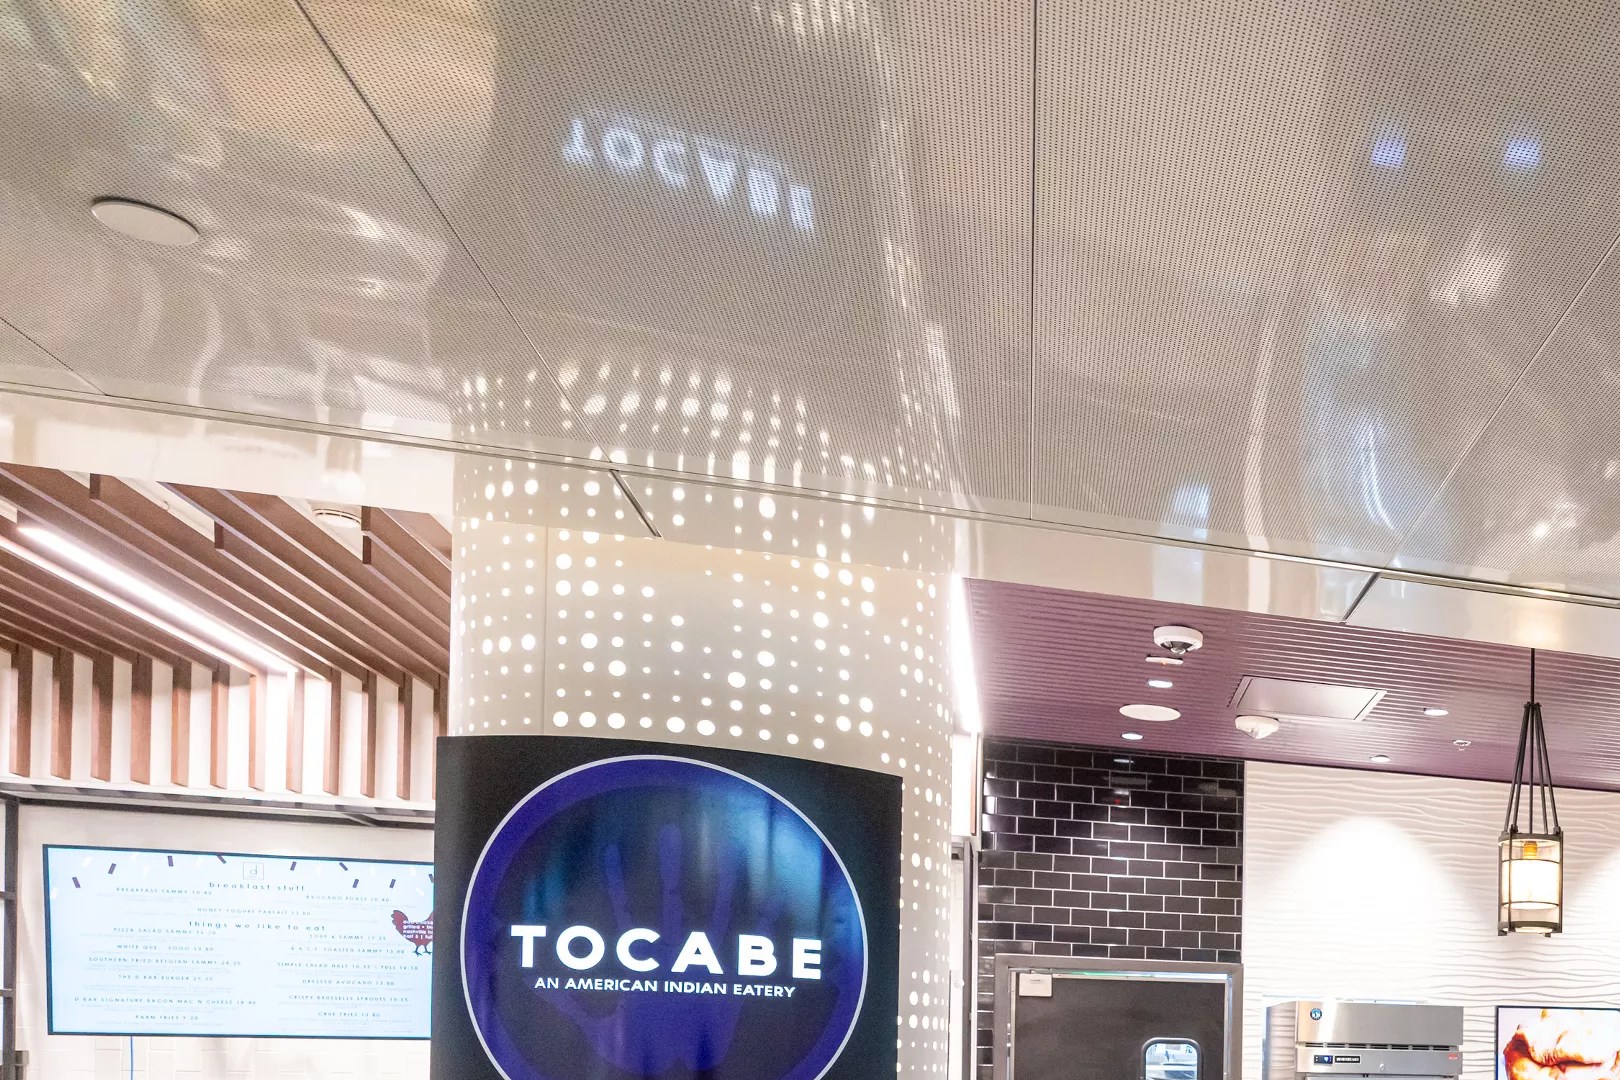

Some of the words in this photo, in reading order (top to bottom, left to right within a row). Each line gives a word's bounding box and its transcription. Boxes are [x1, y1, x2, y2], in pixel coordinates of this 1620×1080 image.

[189, 921, 228, 929] things
[511, 925, 821, 980] TOCABE
[534, 978, 559, 990] AN
[565, 978, 658, 992] AMERICAN
[664, 981, 727, 995] INDIAN
[733, 984, 796, 998] EATERY
